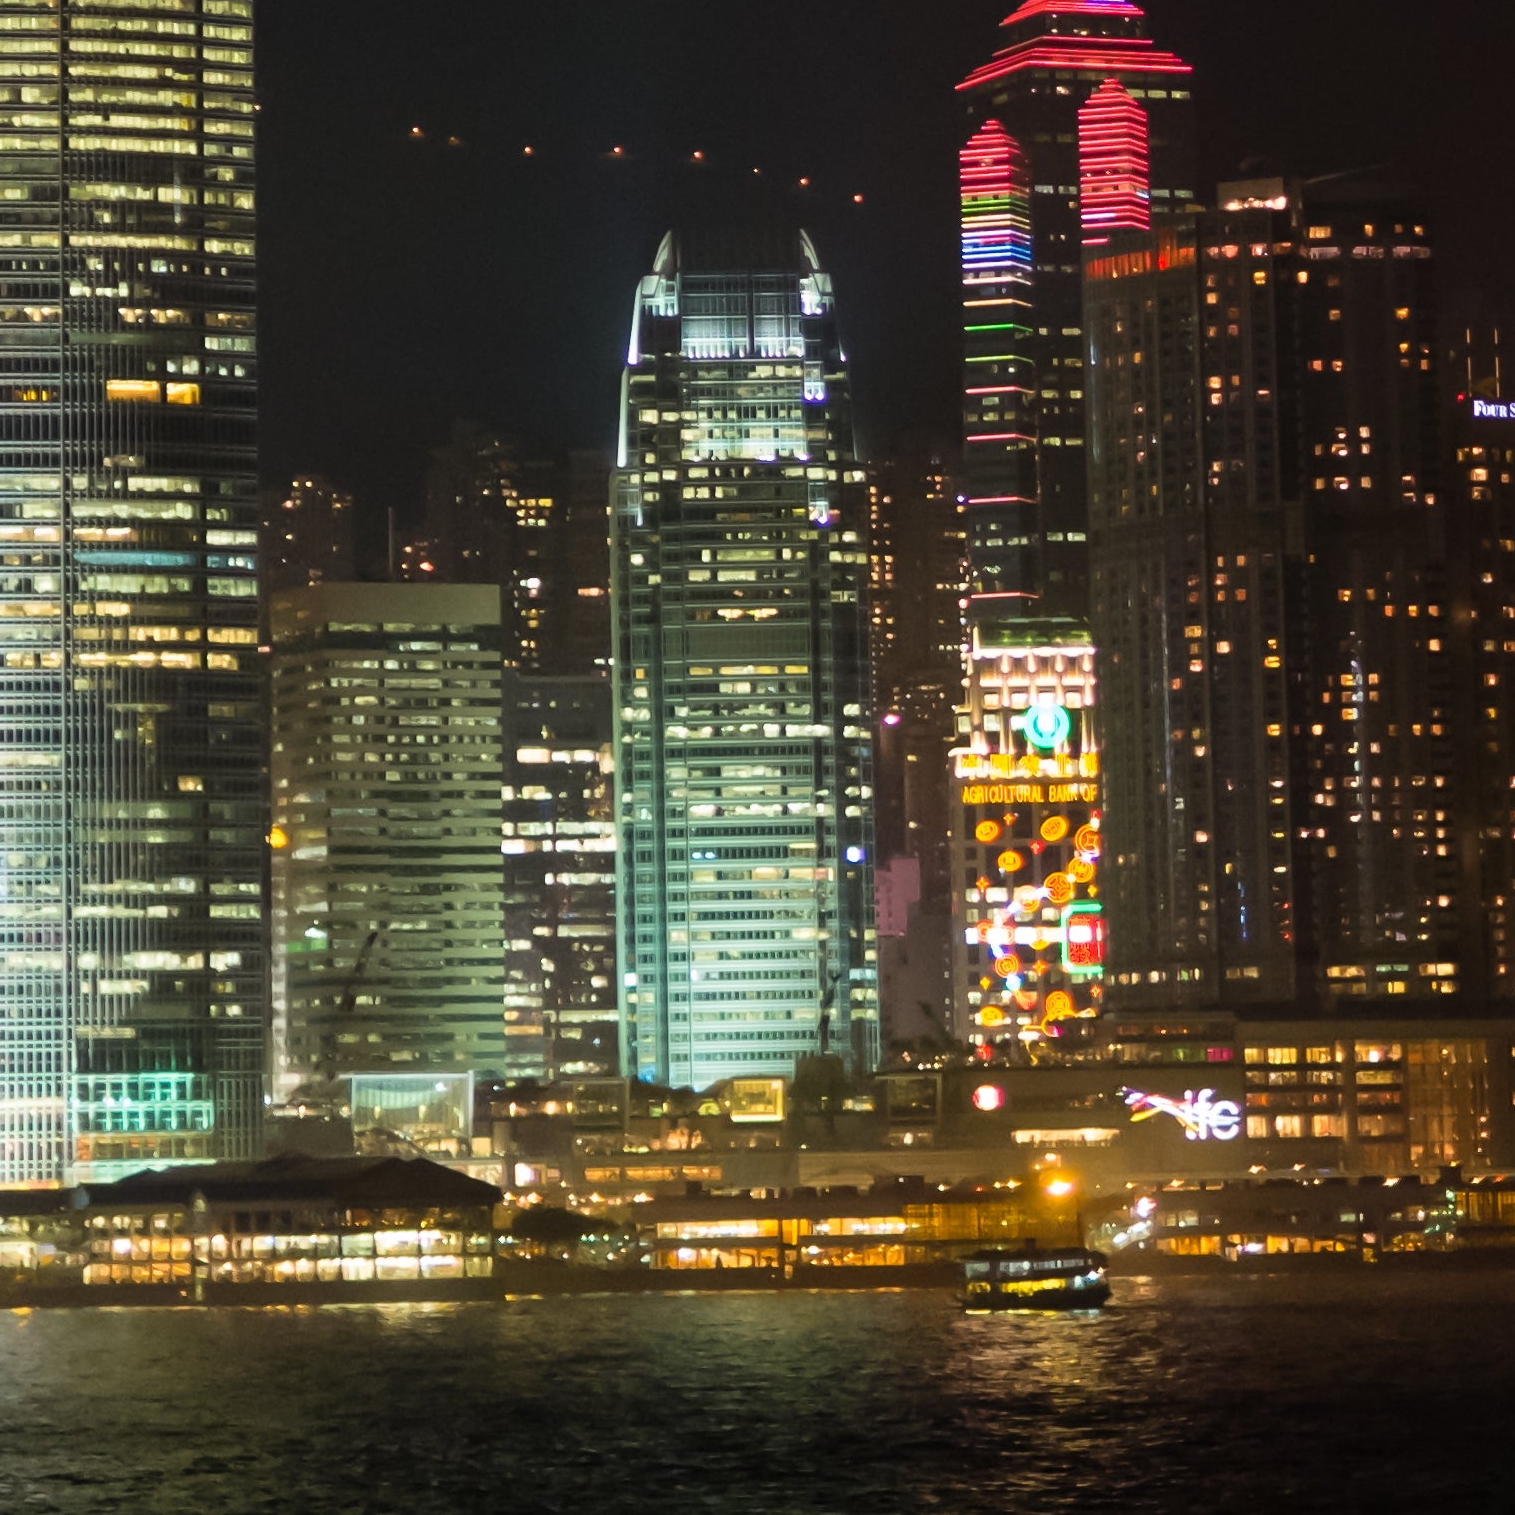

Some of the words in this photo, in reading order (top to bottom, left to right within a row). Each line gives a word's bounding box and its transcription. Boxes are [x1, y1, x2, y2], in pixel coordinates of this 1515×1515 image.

[1472, 399, 1508, 418] FOUR
[962, 784, 1045, 804] AGRICULTURAL
[1048, 783, 1079, 803] BANK
[1082, 783, 1098, 802] OF
[1183, 1088, 1241, 1140] ifc
